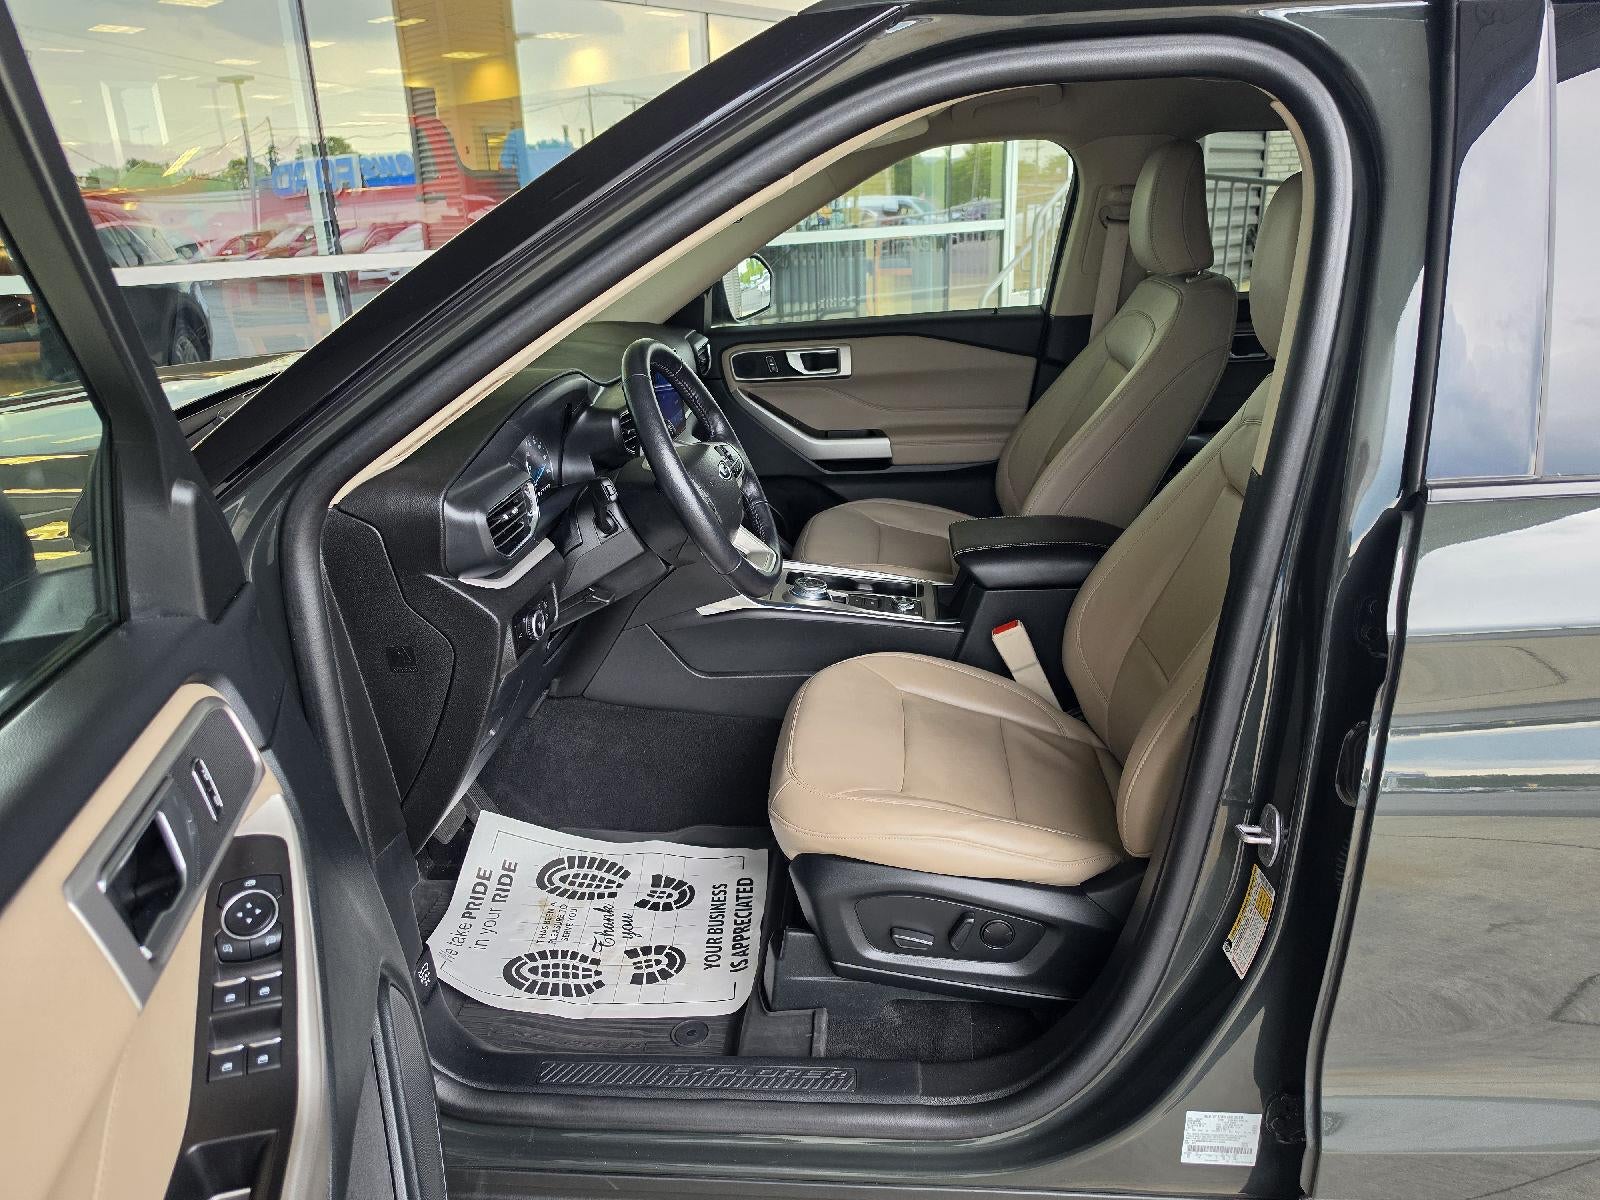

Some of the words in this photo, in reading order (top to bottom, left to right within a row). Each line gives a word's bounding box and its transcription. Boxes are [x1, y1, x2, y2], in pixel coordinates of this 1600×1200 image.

[447, 922, 473, 947] take
[461, 867, 493, 919] PRIDE
[468, 939, 490, 949] in
[480, 908, 502, 935] your
[491, 859, 518, 903] RIDE
[543, 909, 555, 925] BEEN
[707, 884, 728, 934] BUSINESS
[731, 877, 754, 956] APPRECIATED
[560, 923, 574, 942] SERVE
[568, 908, 578, 921] YOU
[592, 903, 615, 952] Thank
[621, 913, 642, 939] you
[704, 937, 723, 970] YOUR
[729, 959, 748, 973] IS
